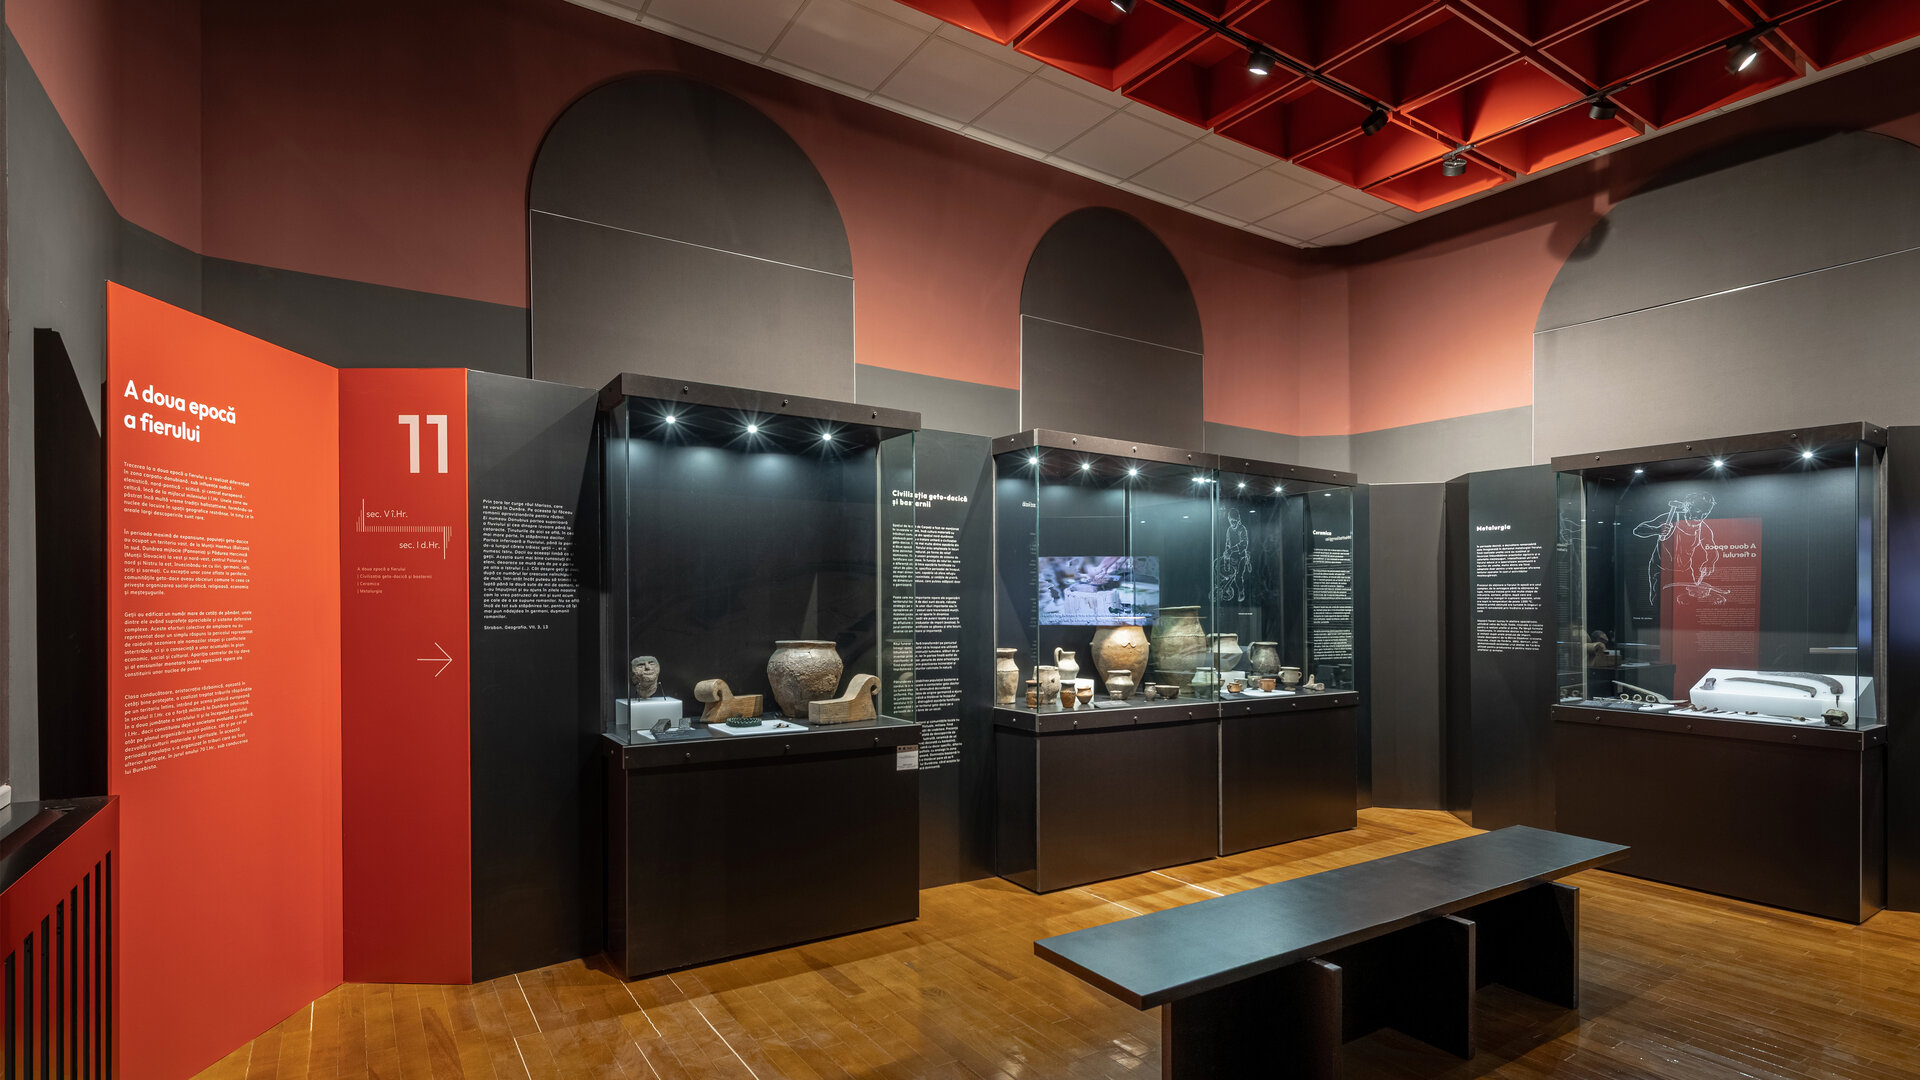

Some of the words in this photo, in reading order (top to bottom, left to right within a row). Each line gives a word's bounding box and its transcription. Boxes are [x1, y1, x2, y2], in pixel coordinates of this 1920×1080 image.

[124, 379, 138, 400] A
[142, 385, 185, 411] doua
[189, 401, 236, 424] epocă
[124, 414, 136, 429] a
[140, 413, 200, 442] fierului
[398, 414, 448, 473] 11
[900, 499, 931, 507] basarnii
[929, 493, 968, 503] geto-dacică
[391, 510, 408, 518] î.Hr.
[420, 541, 440, 549] d.Hr.
